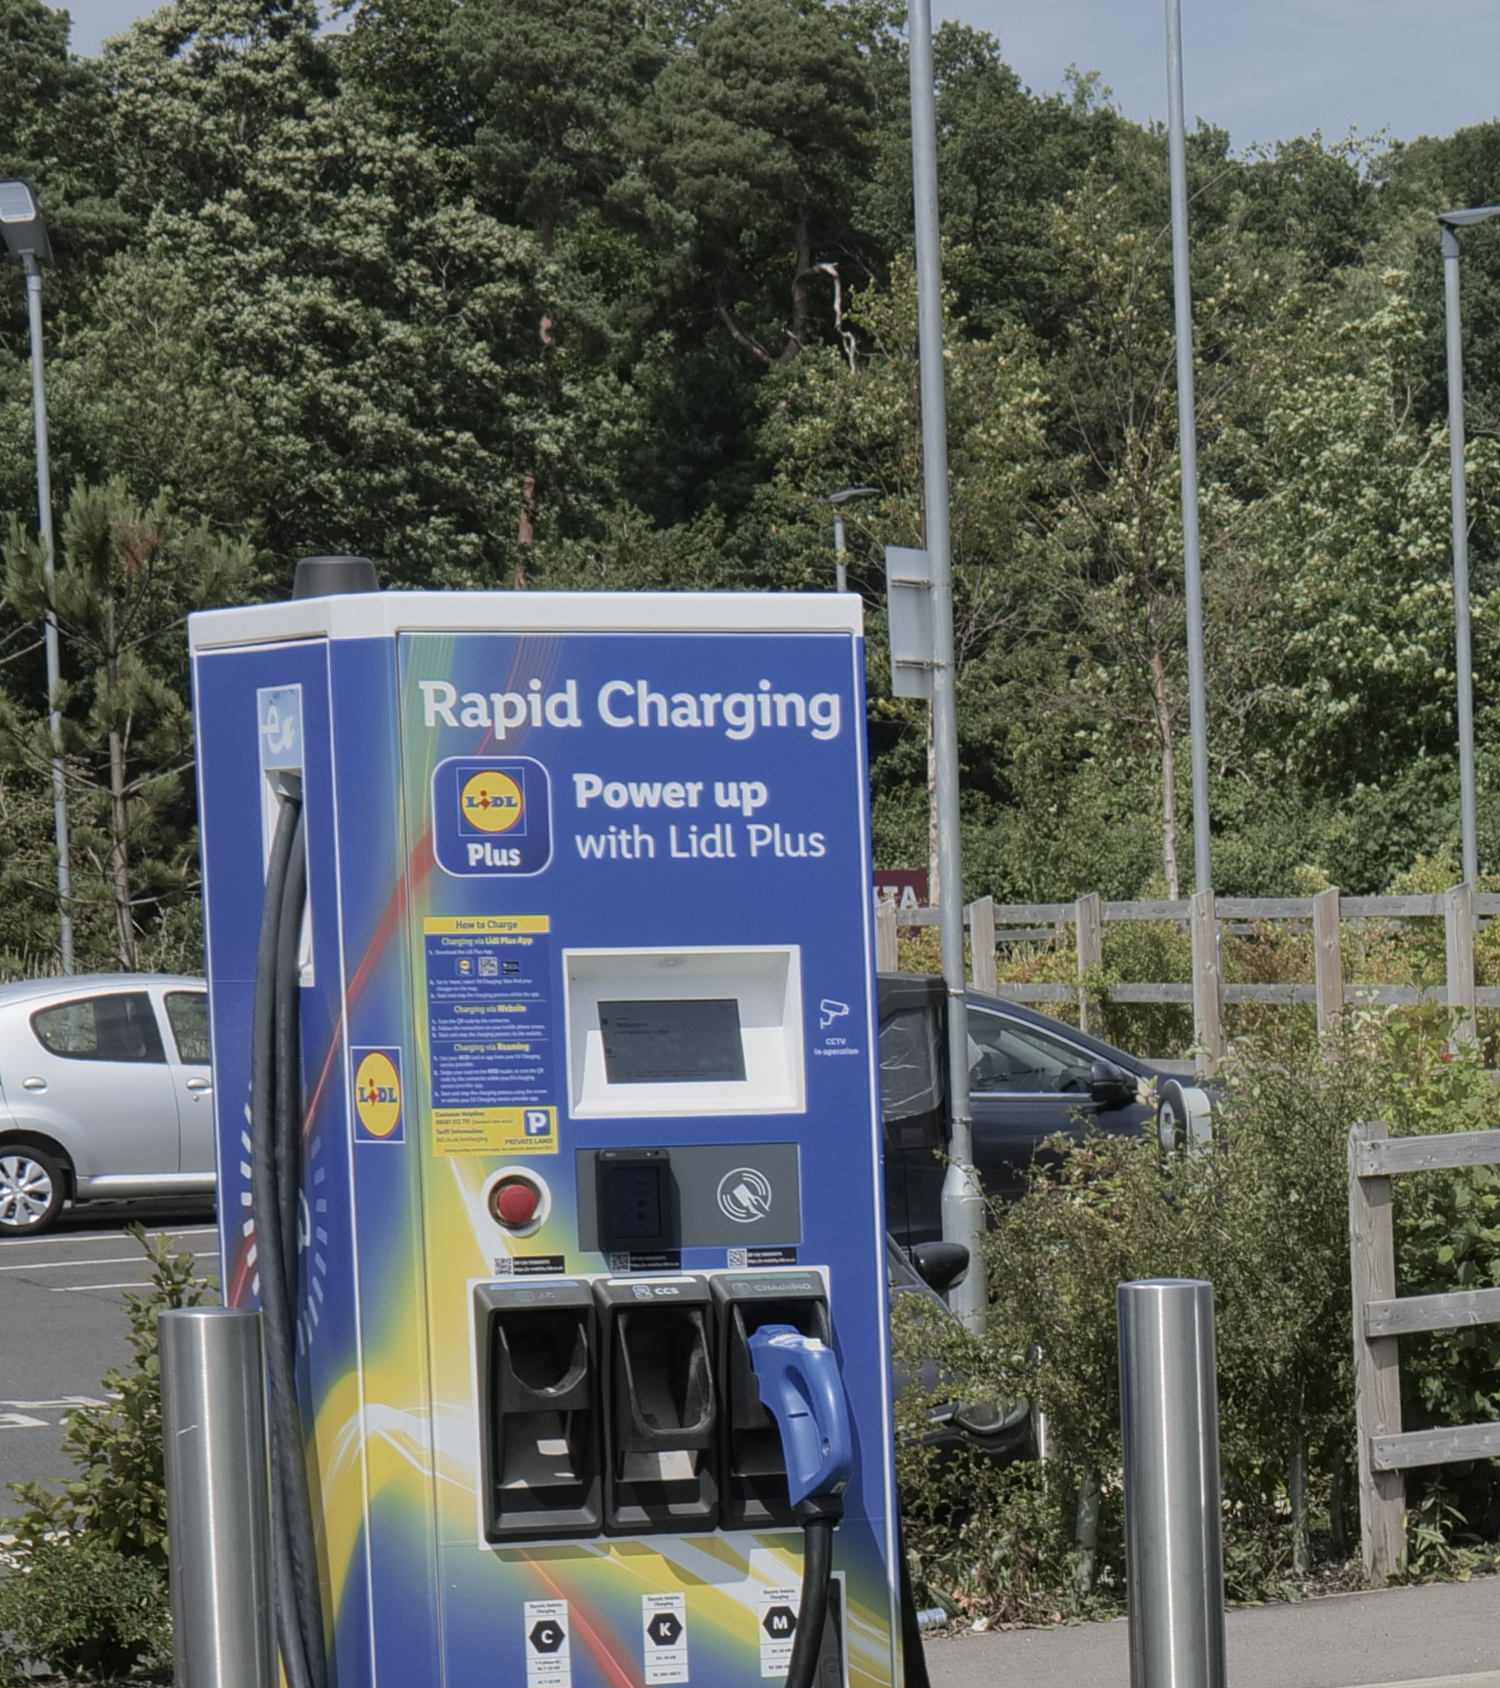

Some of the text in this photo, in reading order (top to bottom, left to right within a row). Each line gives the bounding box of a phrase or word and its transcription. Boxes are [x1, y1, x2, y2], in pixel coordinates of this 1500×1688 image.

[418, 679, 841, 740] Rapid Charging
[465, 789, 518, 811] LIDL
[572, 772, 768, 816] Power up
[575, 823, 826, 859] with Lidl Plus
[467, 842, 521, 866] Plus
[455, 920, 518, 930] How to Charge
[441, 937, 473, 946] Charging
[517, 936, 533, 946] App
[454, 1005, 485, 1014] Charging
[454, 1044, 485, 1053] Charging
[825, 1037, 846, 1046] CCTV
[823, 1047, 859, 1057] operation
[358, 1077, 398, 1107] LIDL
[526, 1112, 547, 1134] P
[655, 1286, 679, 1296] CCS
[754, 1282, 812, 1293] CHAdeMO
[659, 1622, 672, 1637] K
[772, 1615, 788, 1630] M
[541, 1629, 553, 1644] C
